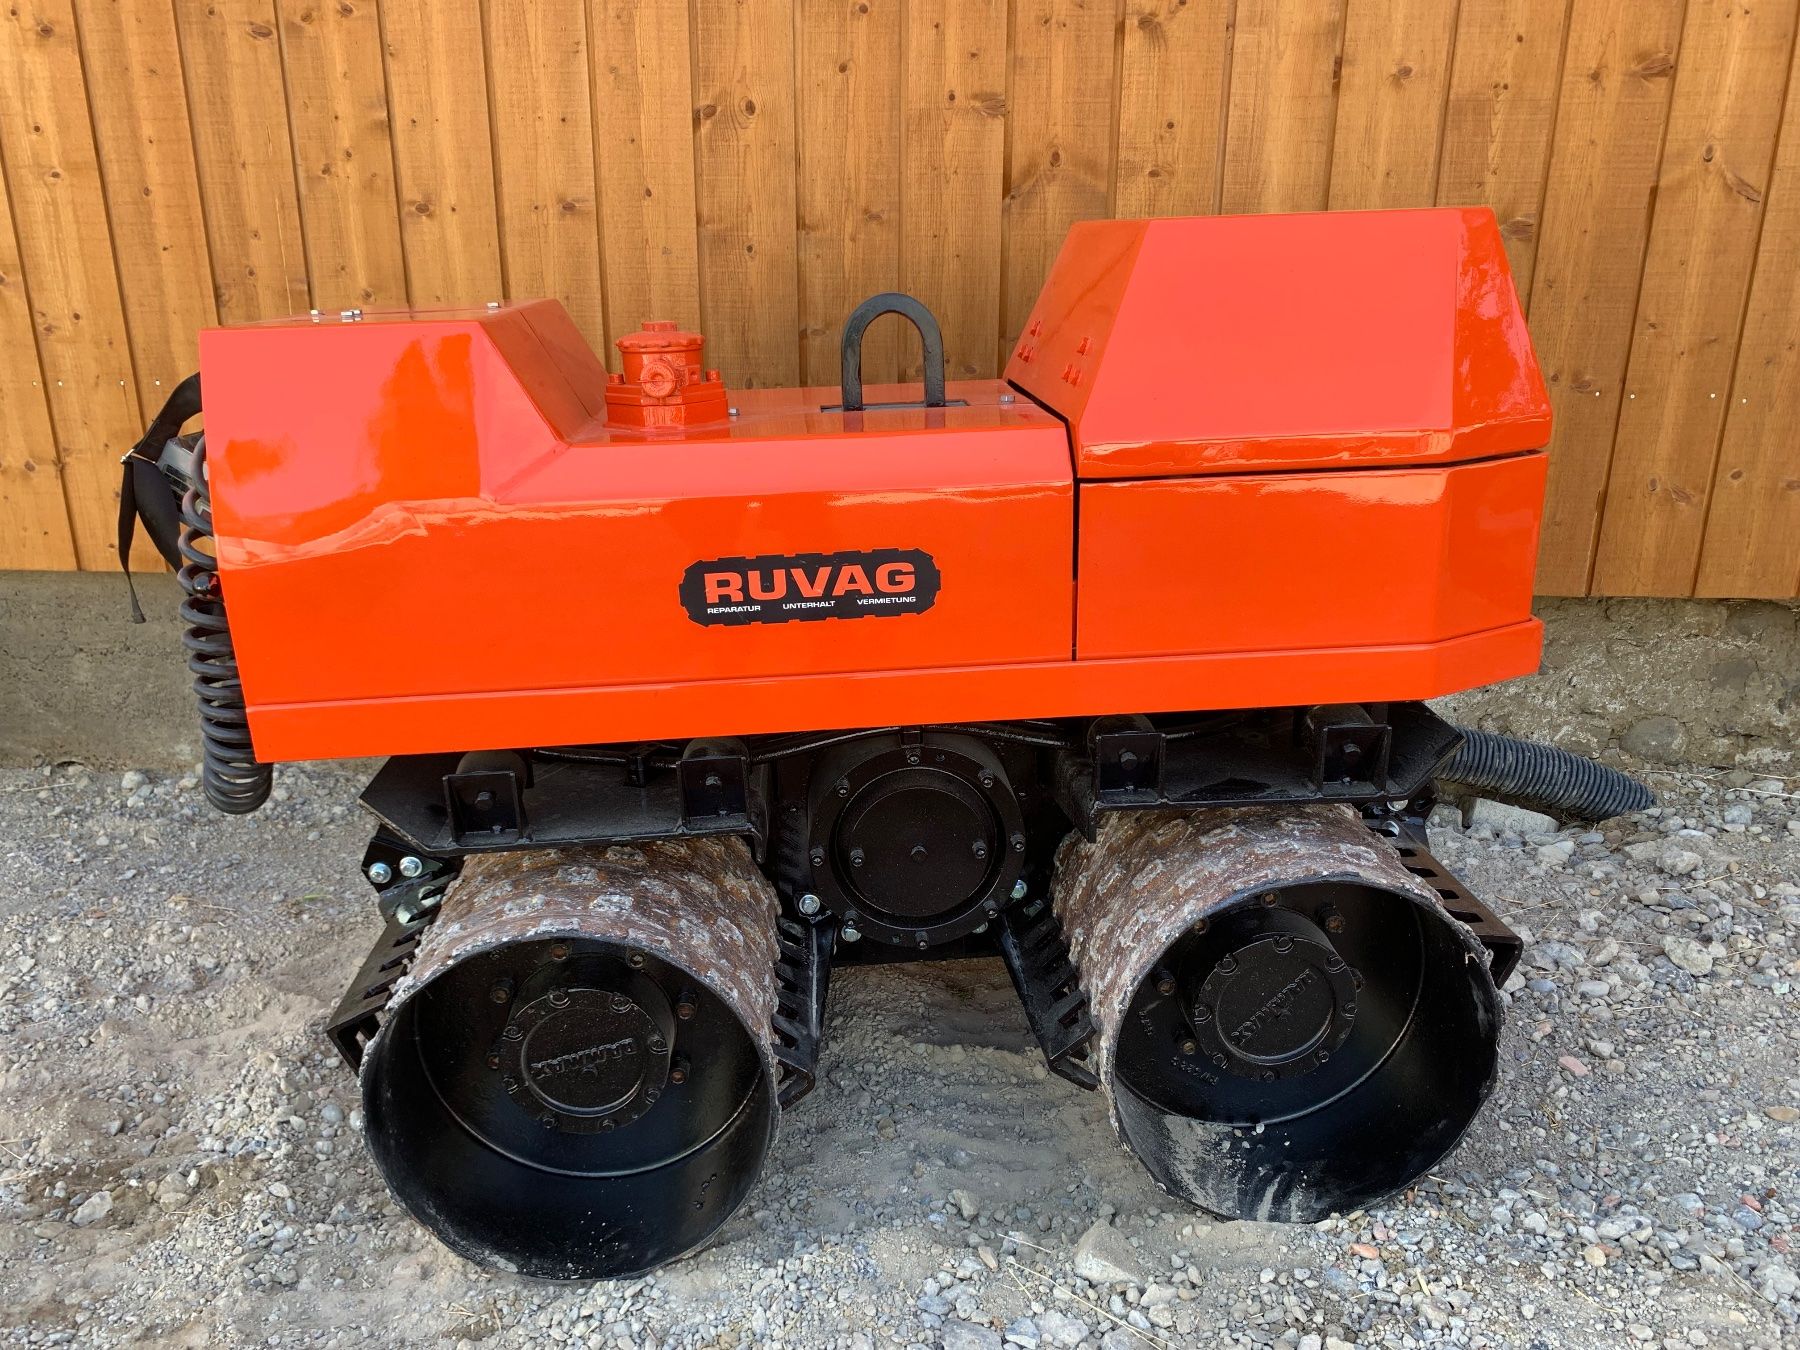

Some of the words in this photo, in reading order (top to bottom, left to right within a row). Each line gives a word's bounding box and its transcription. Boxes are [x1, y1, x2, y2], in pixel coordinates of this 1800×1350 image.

[704, 562, 915, 604] RUVAG
[707, 605, 761, 614] REPARATUR
[783, 600, 836, 610] UNTERHALT
[856, 596, 917, 606] VERMIETUNG
